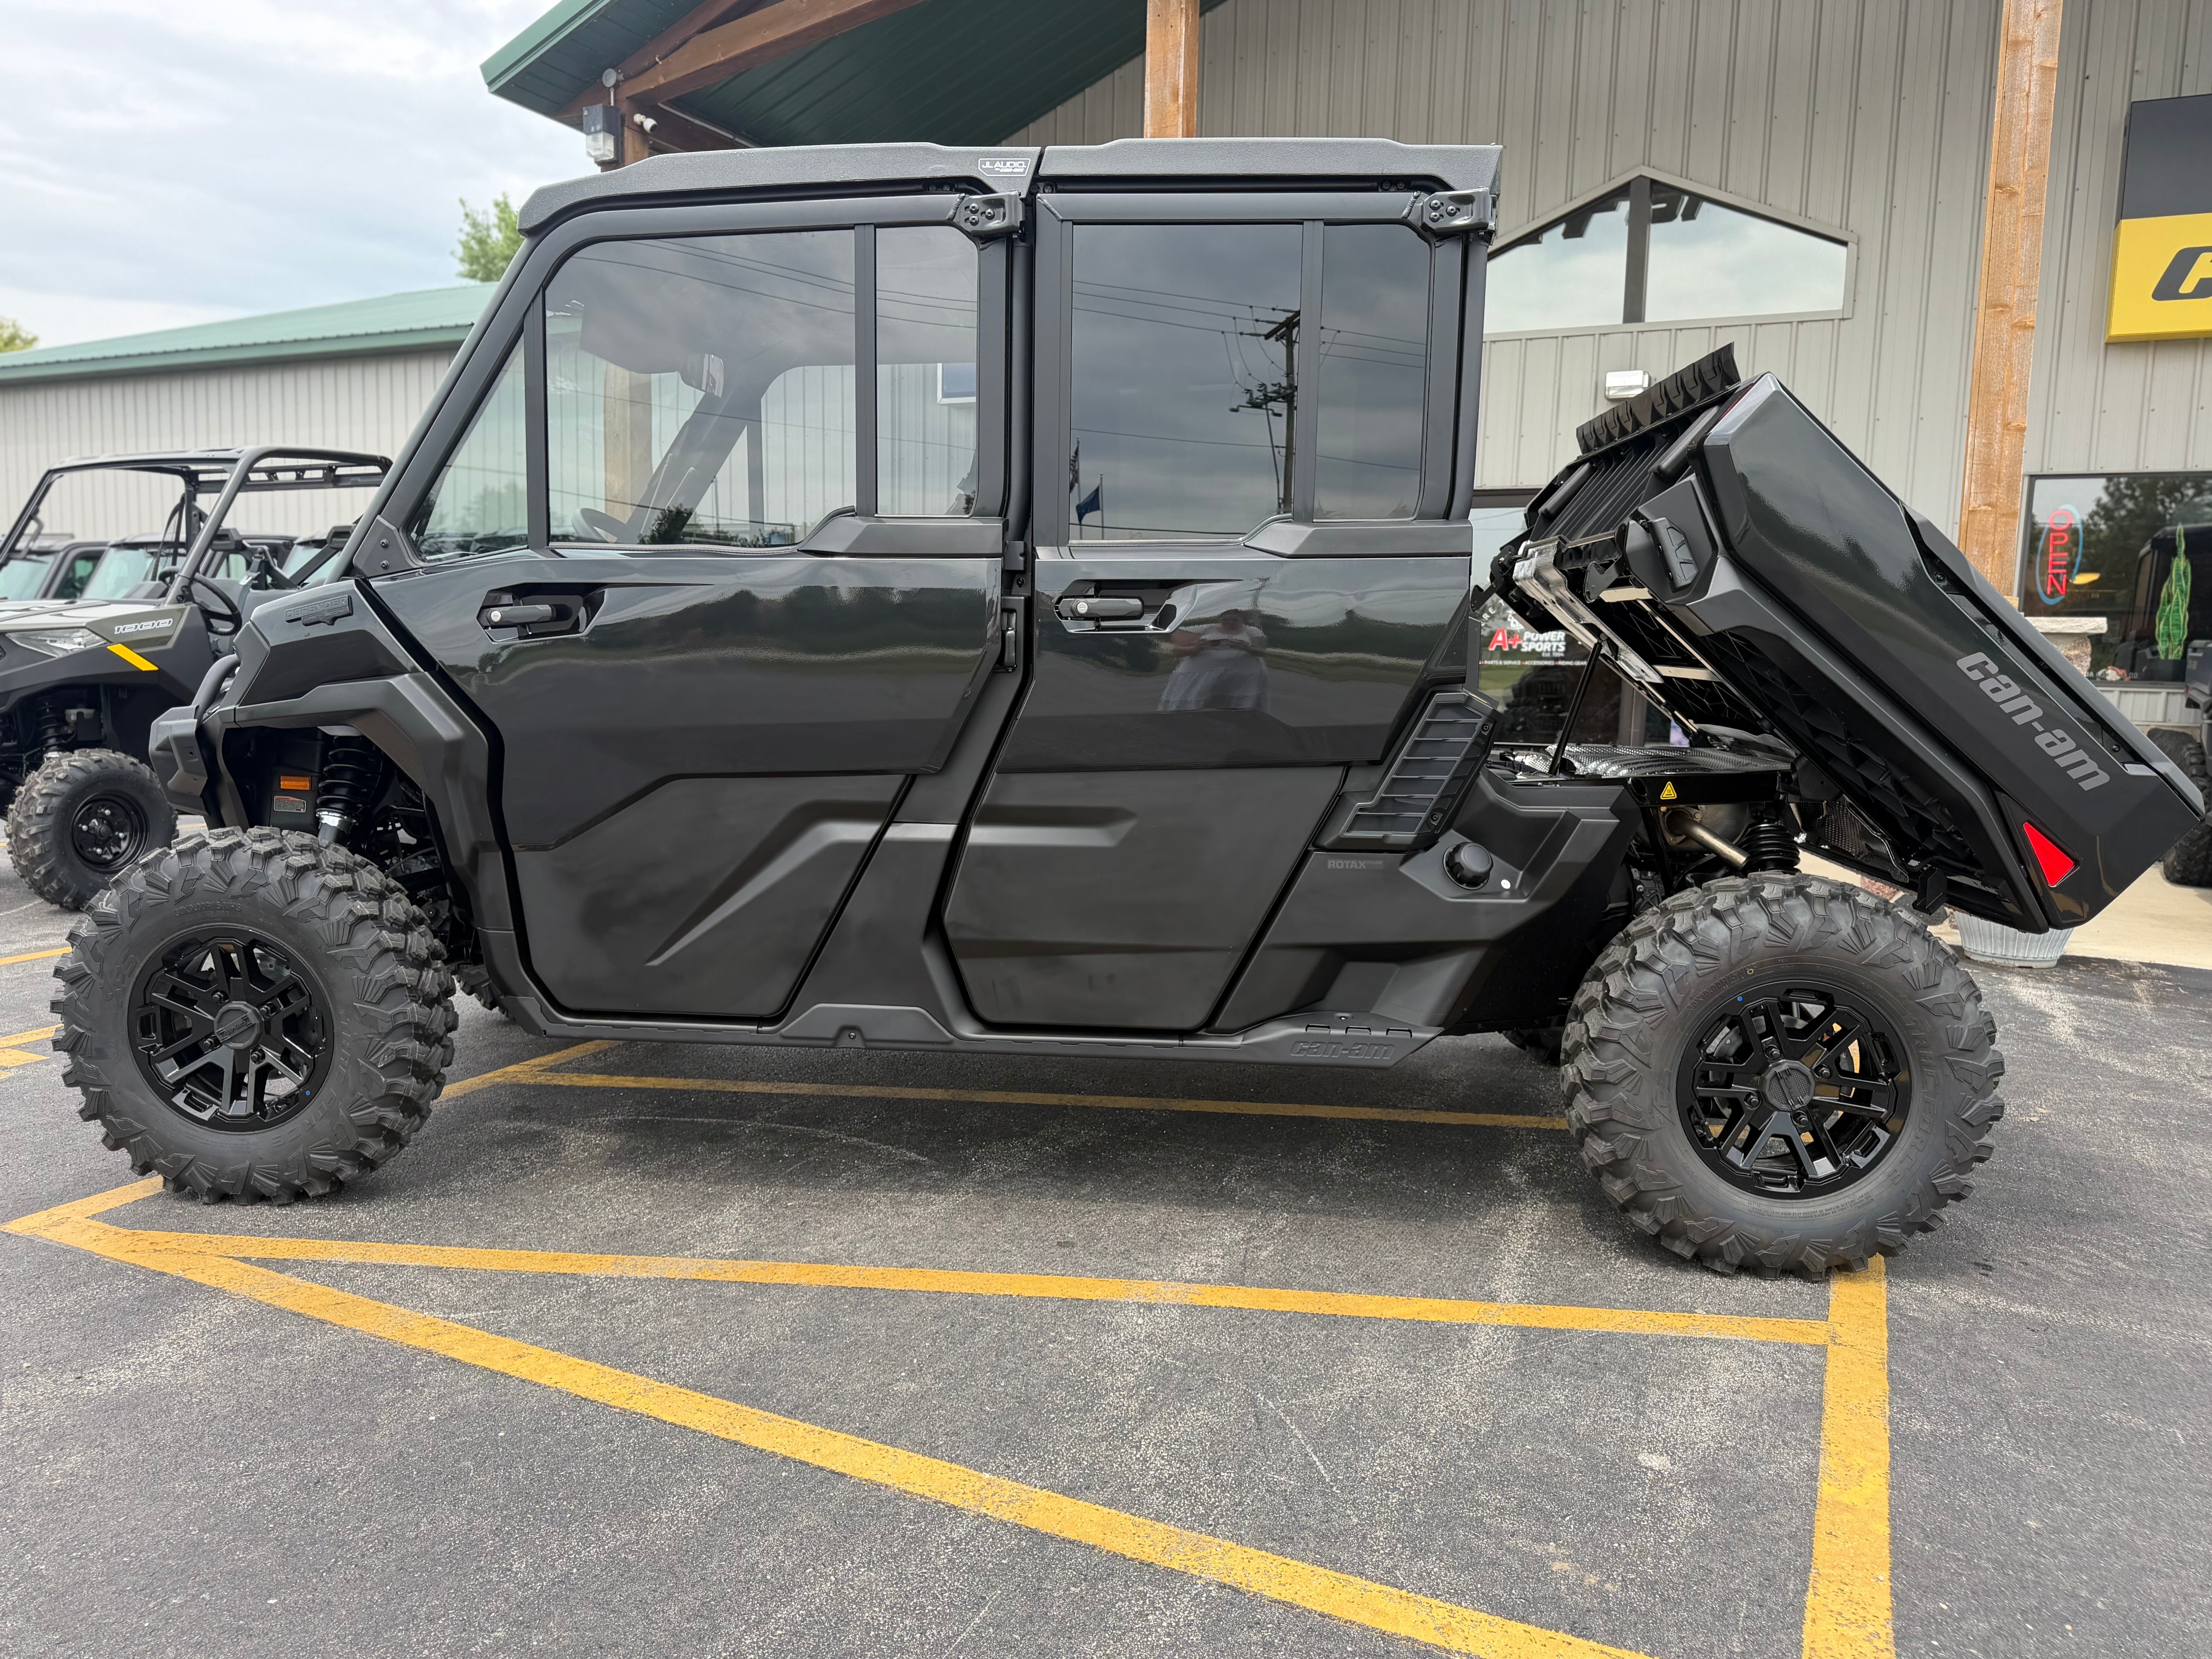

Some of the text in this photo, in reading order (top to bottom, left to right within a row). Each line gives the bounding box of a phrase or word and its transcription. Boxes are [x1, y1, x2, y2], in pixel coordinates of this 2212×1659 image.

[2047, 509, 2072, 594] OPEN
[286, 598, 346, 617] DEFENDER
[115, 618, 173, 634] 1000
[1488, 628, 1566, 651] A+ POWER
[1521, 642, 1566, 652] SPORTS
[1956, 652, 2110, 791] can-am
[1328, 860, 1366, 869] ROTAX
[1290, 1041, 1395, 1059] can-am
[1888, 1096, 1938, 1185] FORCE
